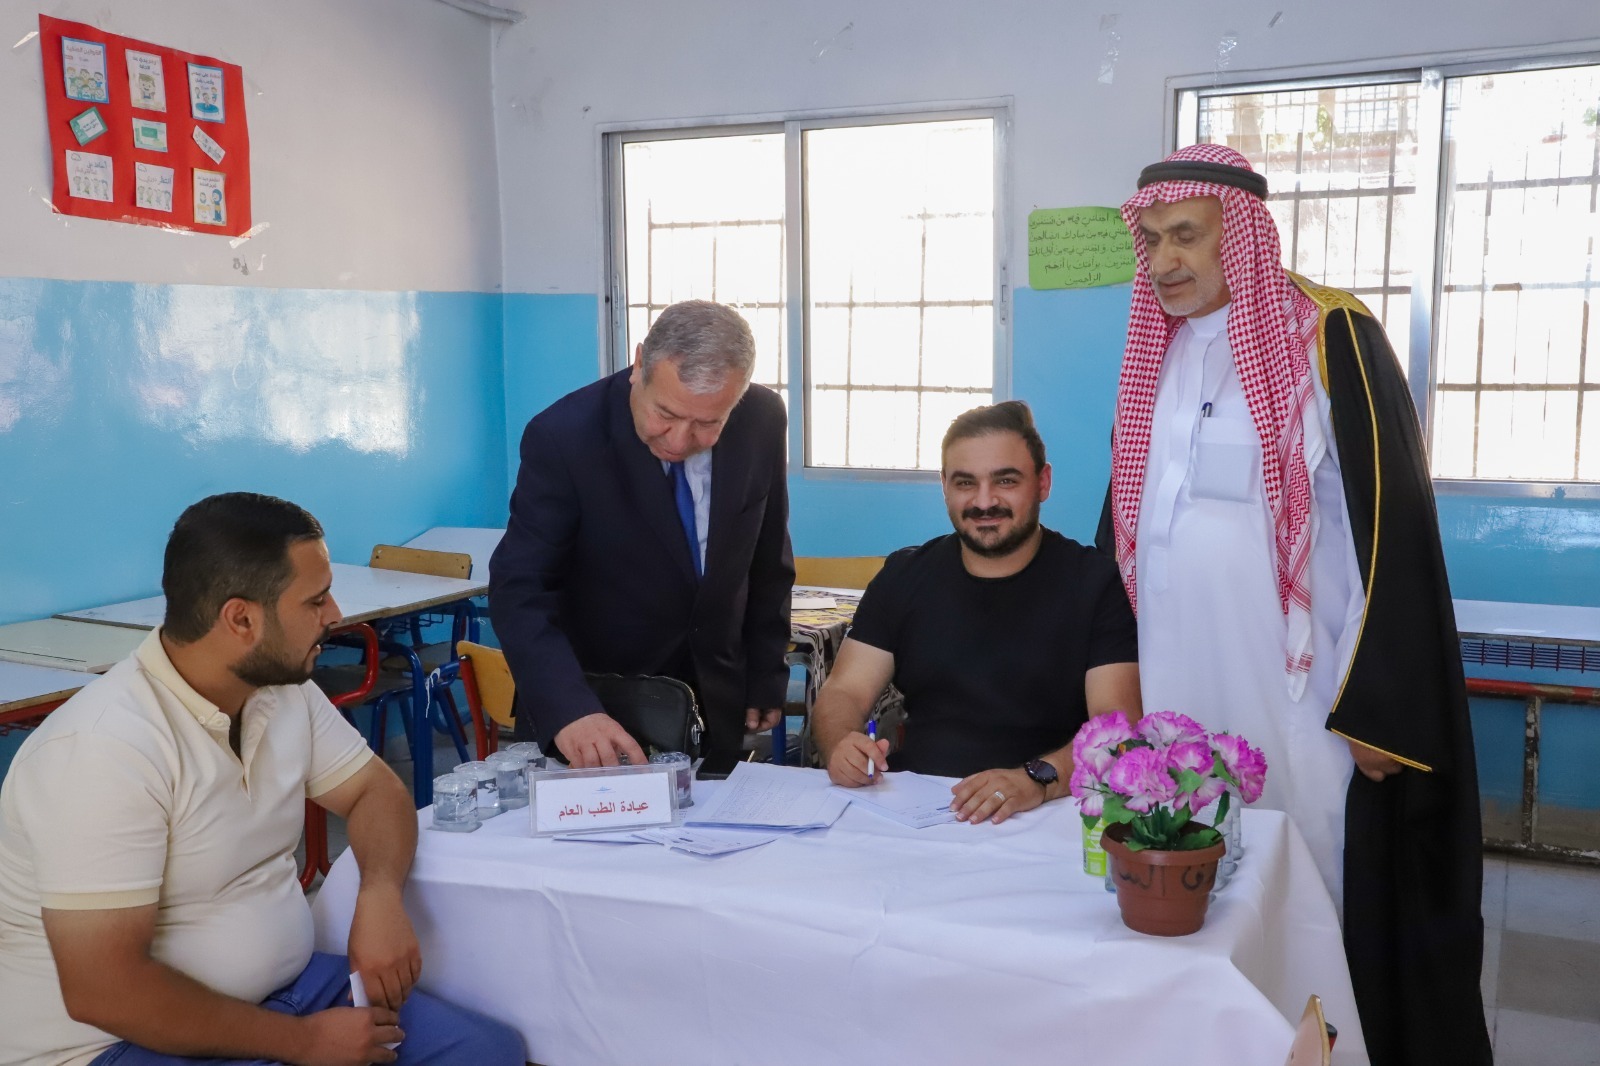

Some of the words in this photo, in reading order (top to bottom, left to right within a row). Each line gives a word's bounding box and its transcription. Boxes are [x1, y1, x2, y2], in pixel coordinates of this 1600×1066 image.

[558, 804, 583, 822] العام
[588, 801, 616, 817] الطب
[620, 800, 649, 815] عيادة
